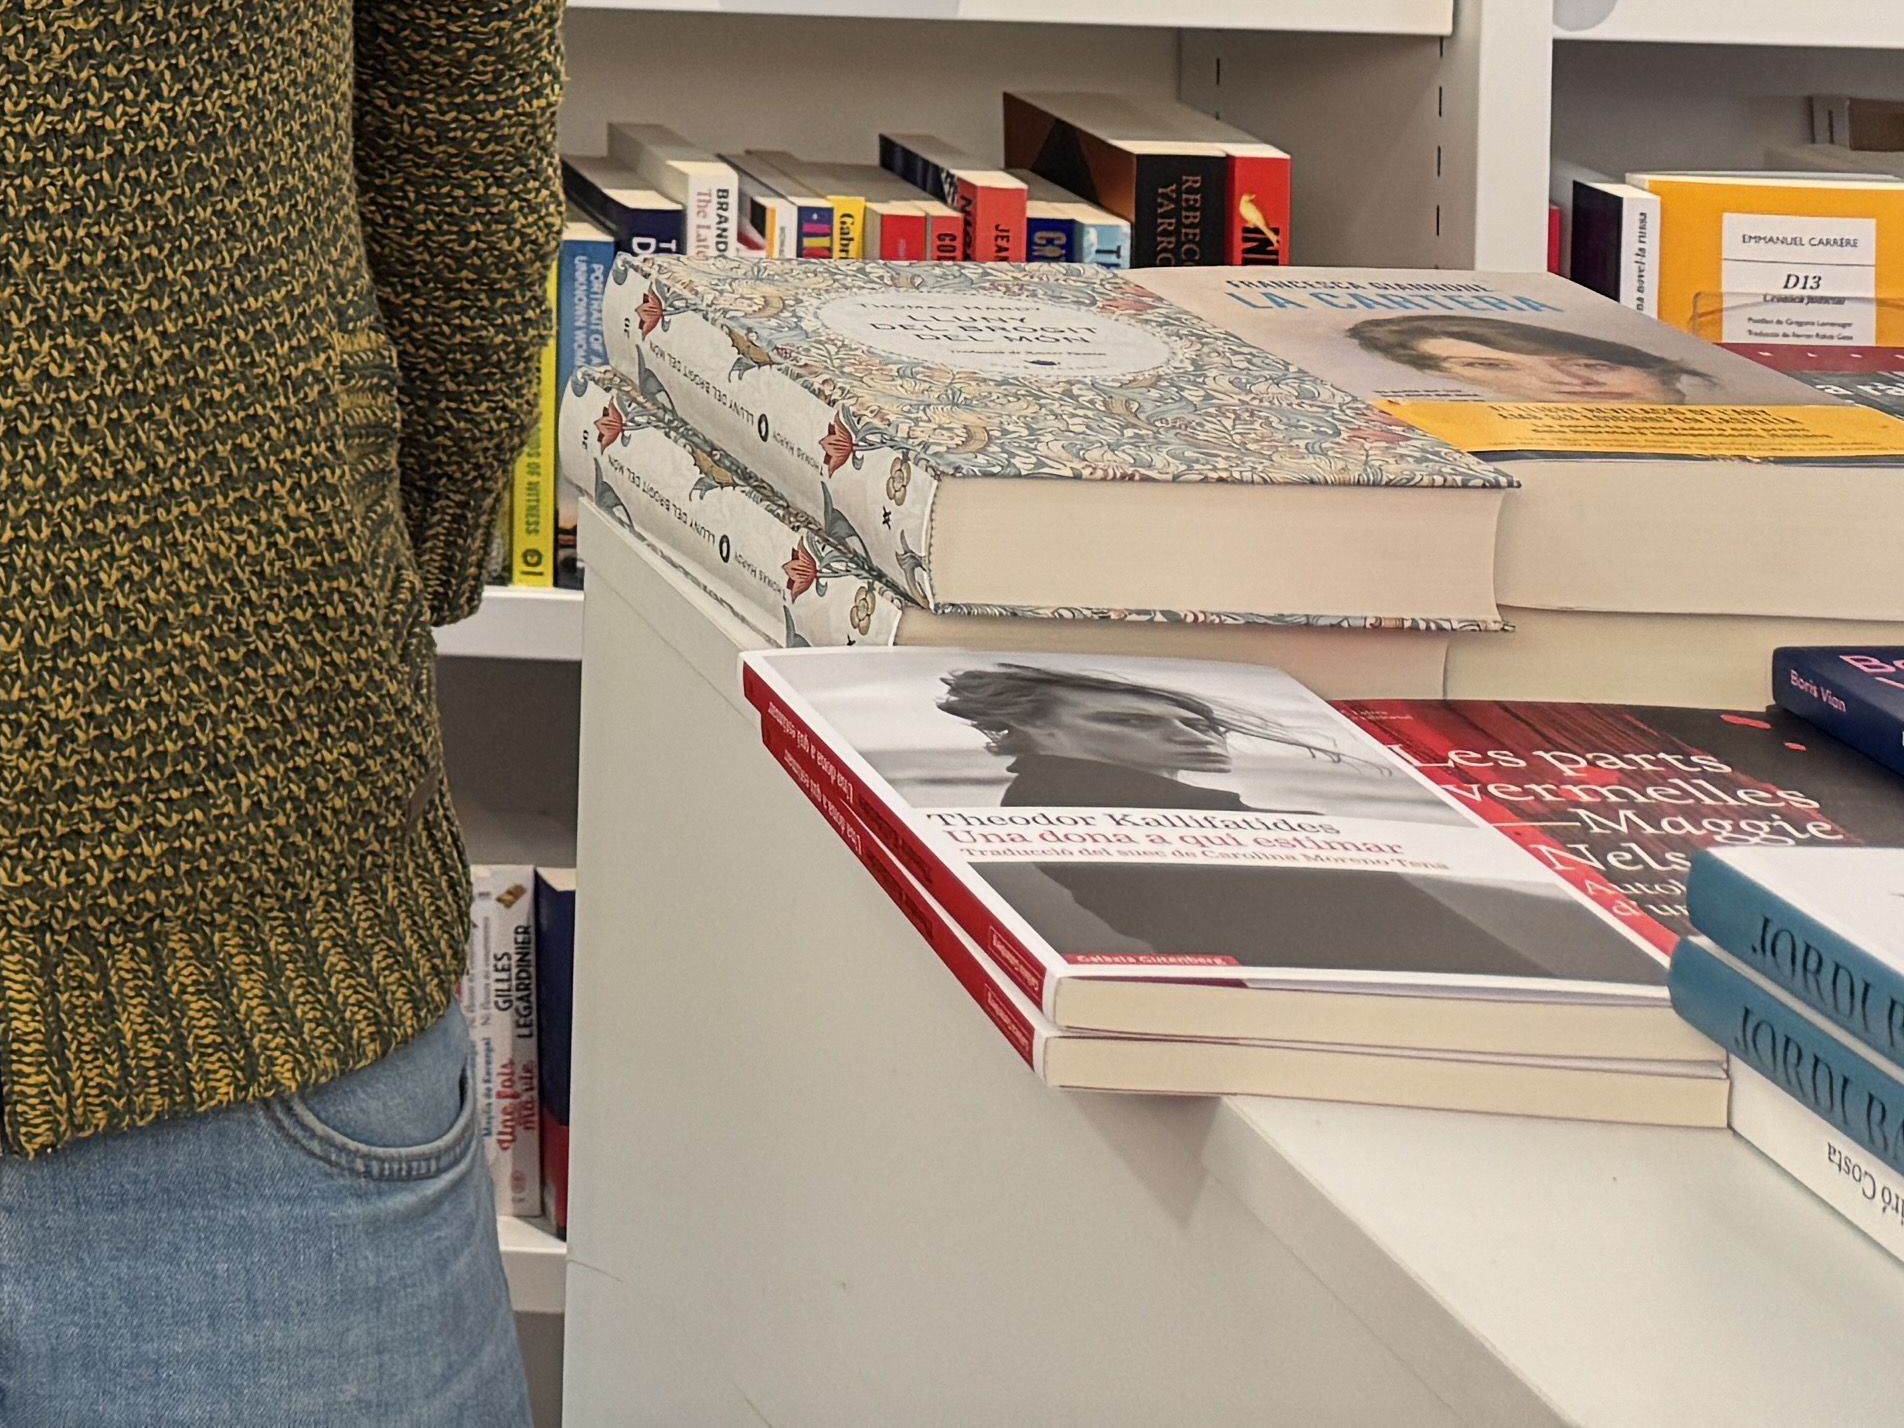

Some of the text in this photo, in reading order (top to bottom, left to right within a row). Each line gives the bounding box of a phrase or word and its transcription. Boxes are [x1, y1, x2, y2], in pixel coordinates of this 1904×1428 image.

[1742, 234, 1805, 247] EMMANUEL
[1783, 273, 1822, 290] D13
[1314, 293, 1565, 314] CARTERA
[1789, 668, 1849, 715] Boris Vian
[1388, 743, 1733, 776] Les parts
[1439, 778, 1820, 809] vermelles
[928, 812, 1341, 835] Theodor Kallifatides
[945, 829, 1404, 856] Una dona a qui estimar
